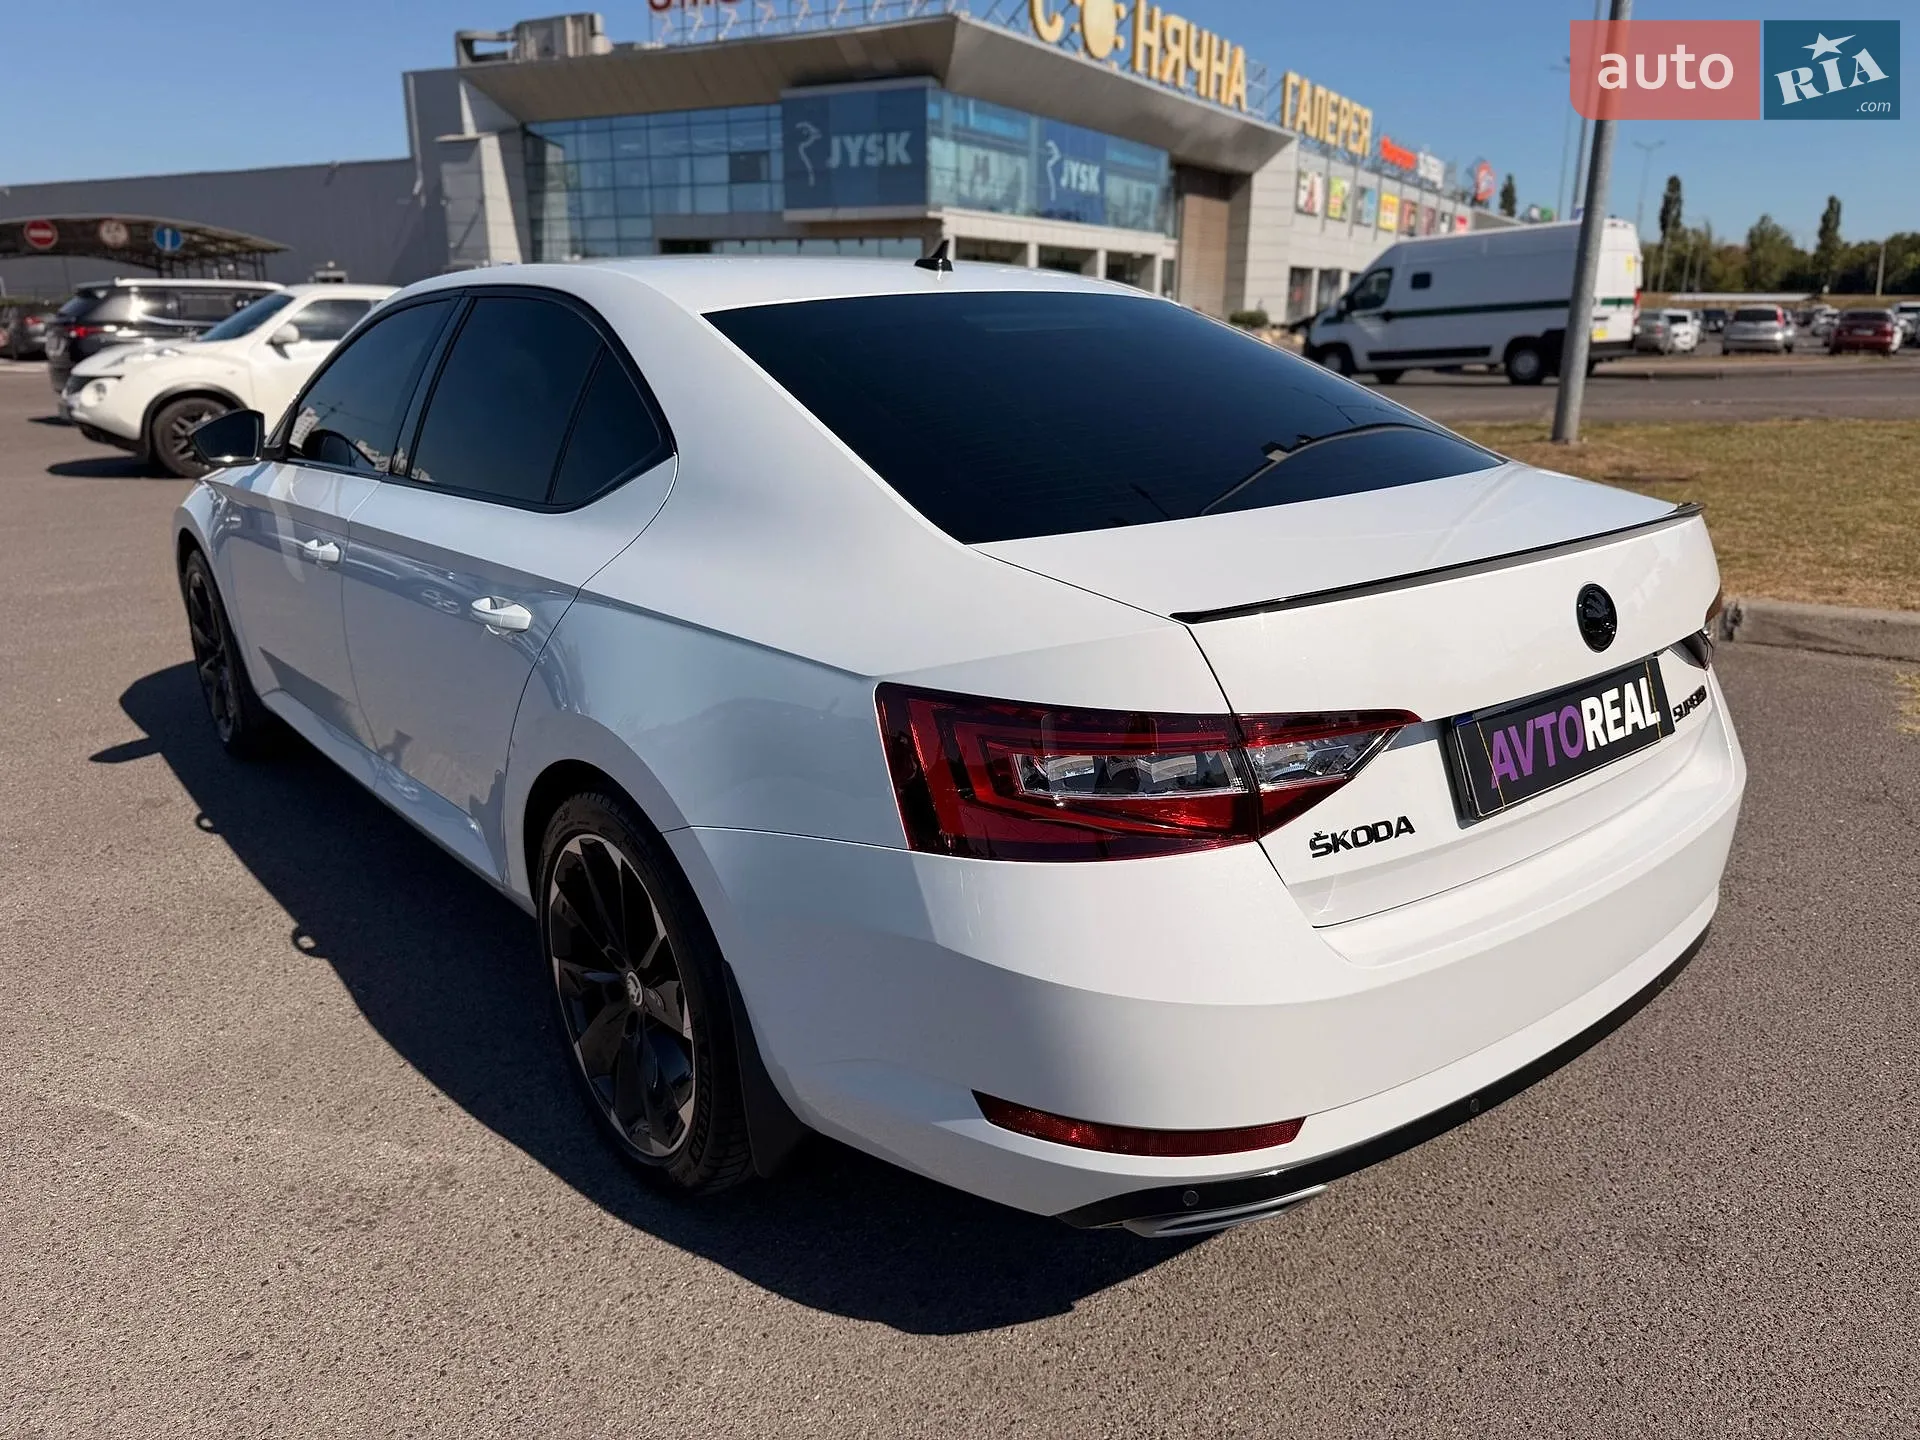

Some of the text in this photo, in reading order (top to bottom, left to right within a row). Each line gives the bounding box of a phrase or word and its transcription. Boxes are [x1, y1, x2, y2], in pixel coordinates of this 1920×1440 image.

[1282, 71, 1373, 157] ГАЛЕРЕЯ
[826, 131, 913, 169] JYSK
[1060, 159, 1100, 193] JYSK
[1490, 677, 1661, 789] AVTOREAL
[1309, 816, 1416, 858] ŠKODA
